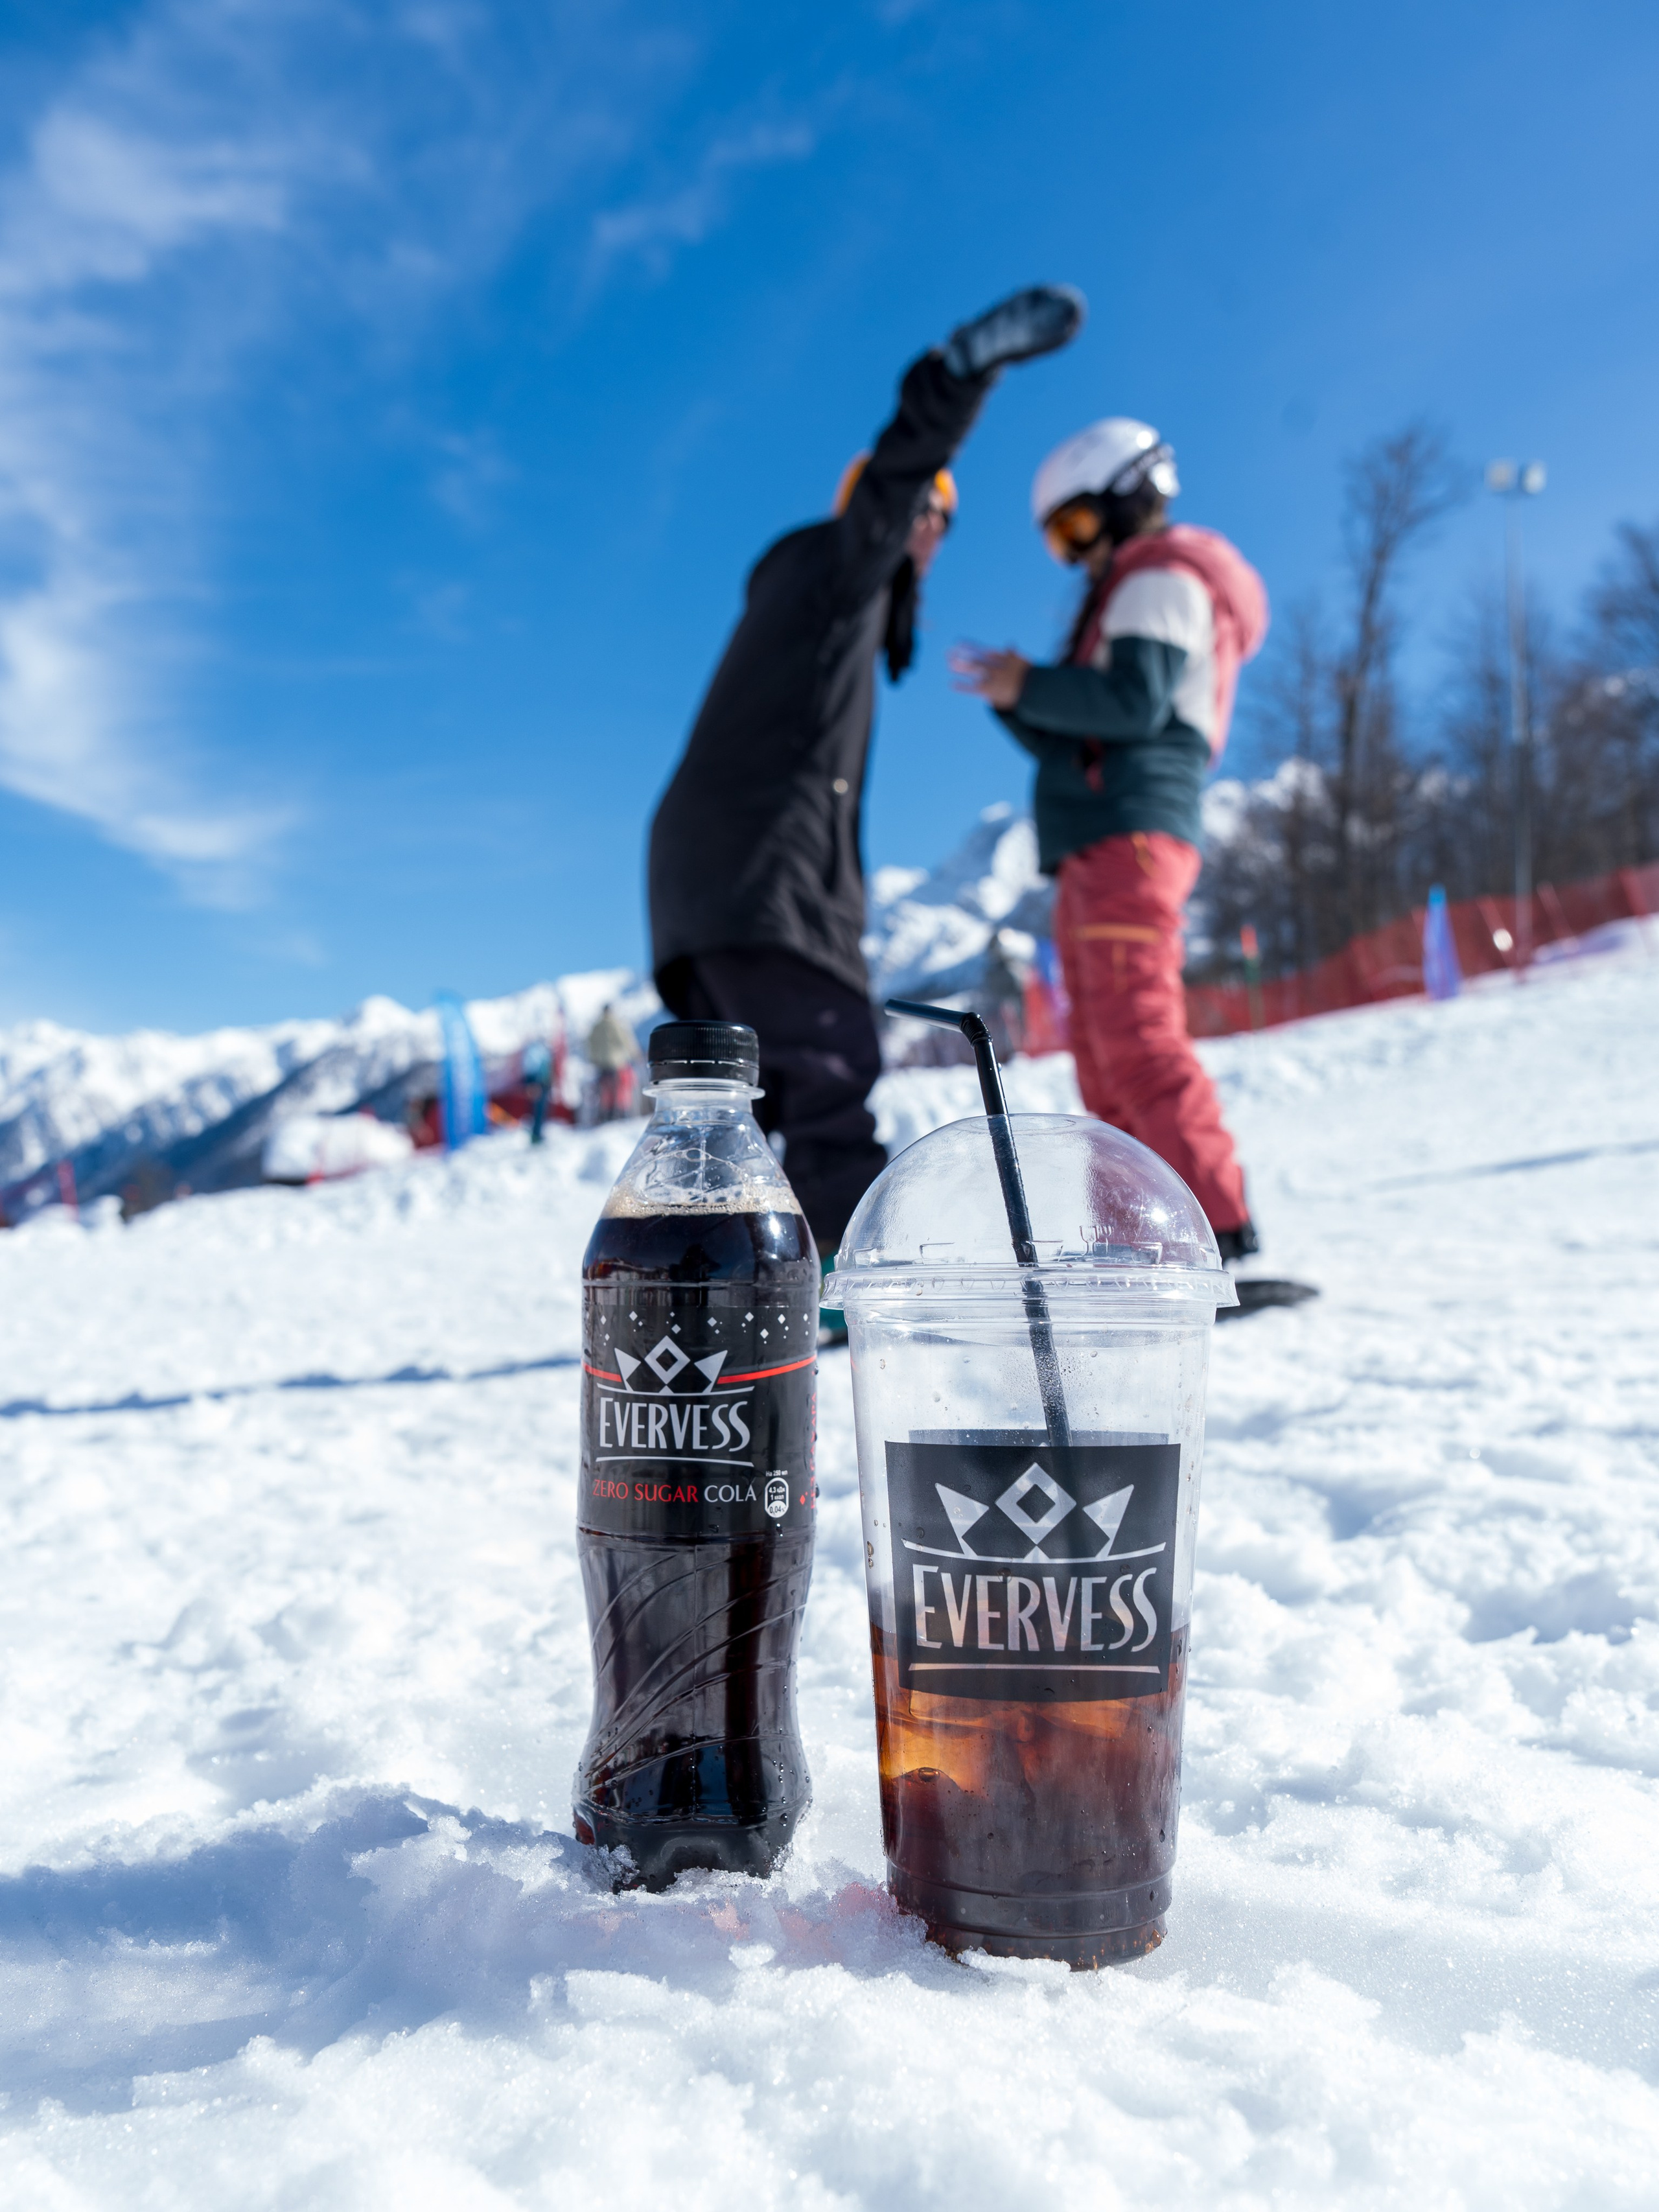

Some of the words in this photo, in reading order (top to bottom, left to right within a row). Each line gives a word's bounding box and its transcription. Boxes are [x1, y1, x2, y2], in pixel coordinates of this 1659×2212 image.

[599, 1397, 750, 1452] EVERVESS
[592, 1479, 629, 1500] ZERO
[634, 1484, 699, 1503] SUGAR
[704, 1485, 757, 1502] COLA
[912, 1564, 1157, 1652] EVERVESS
